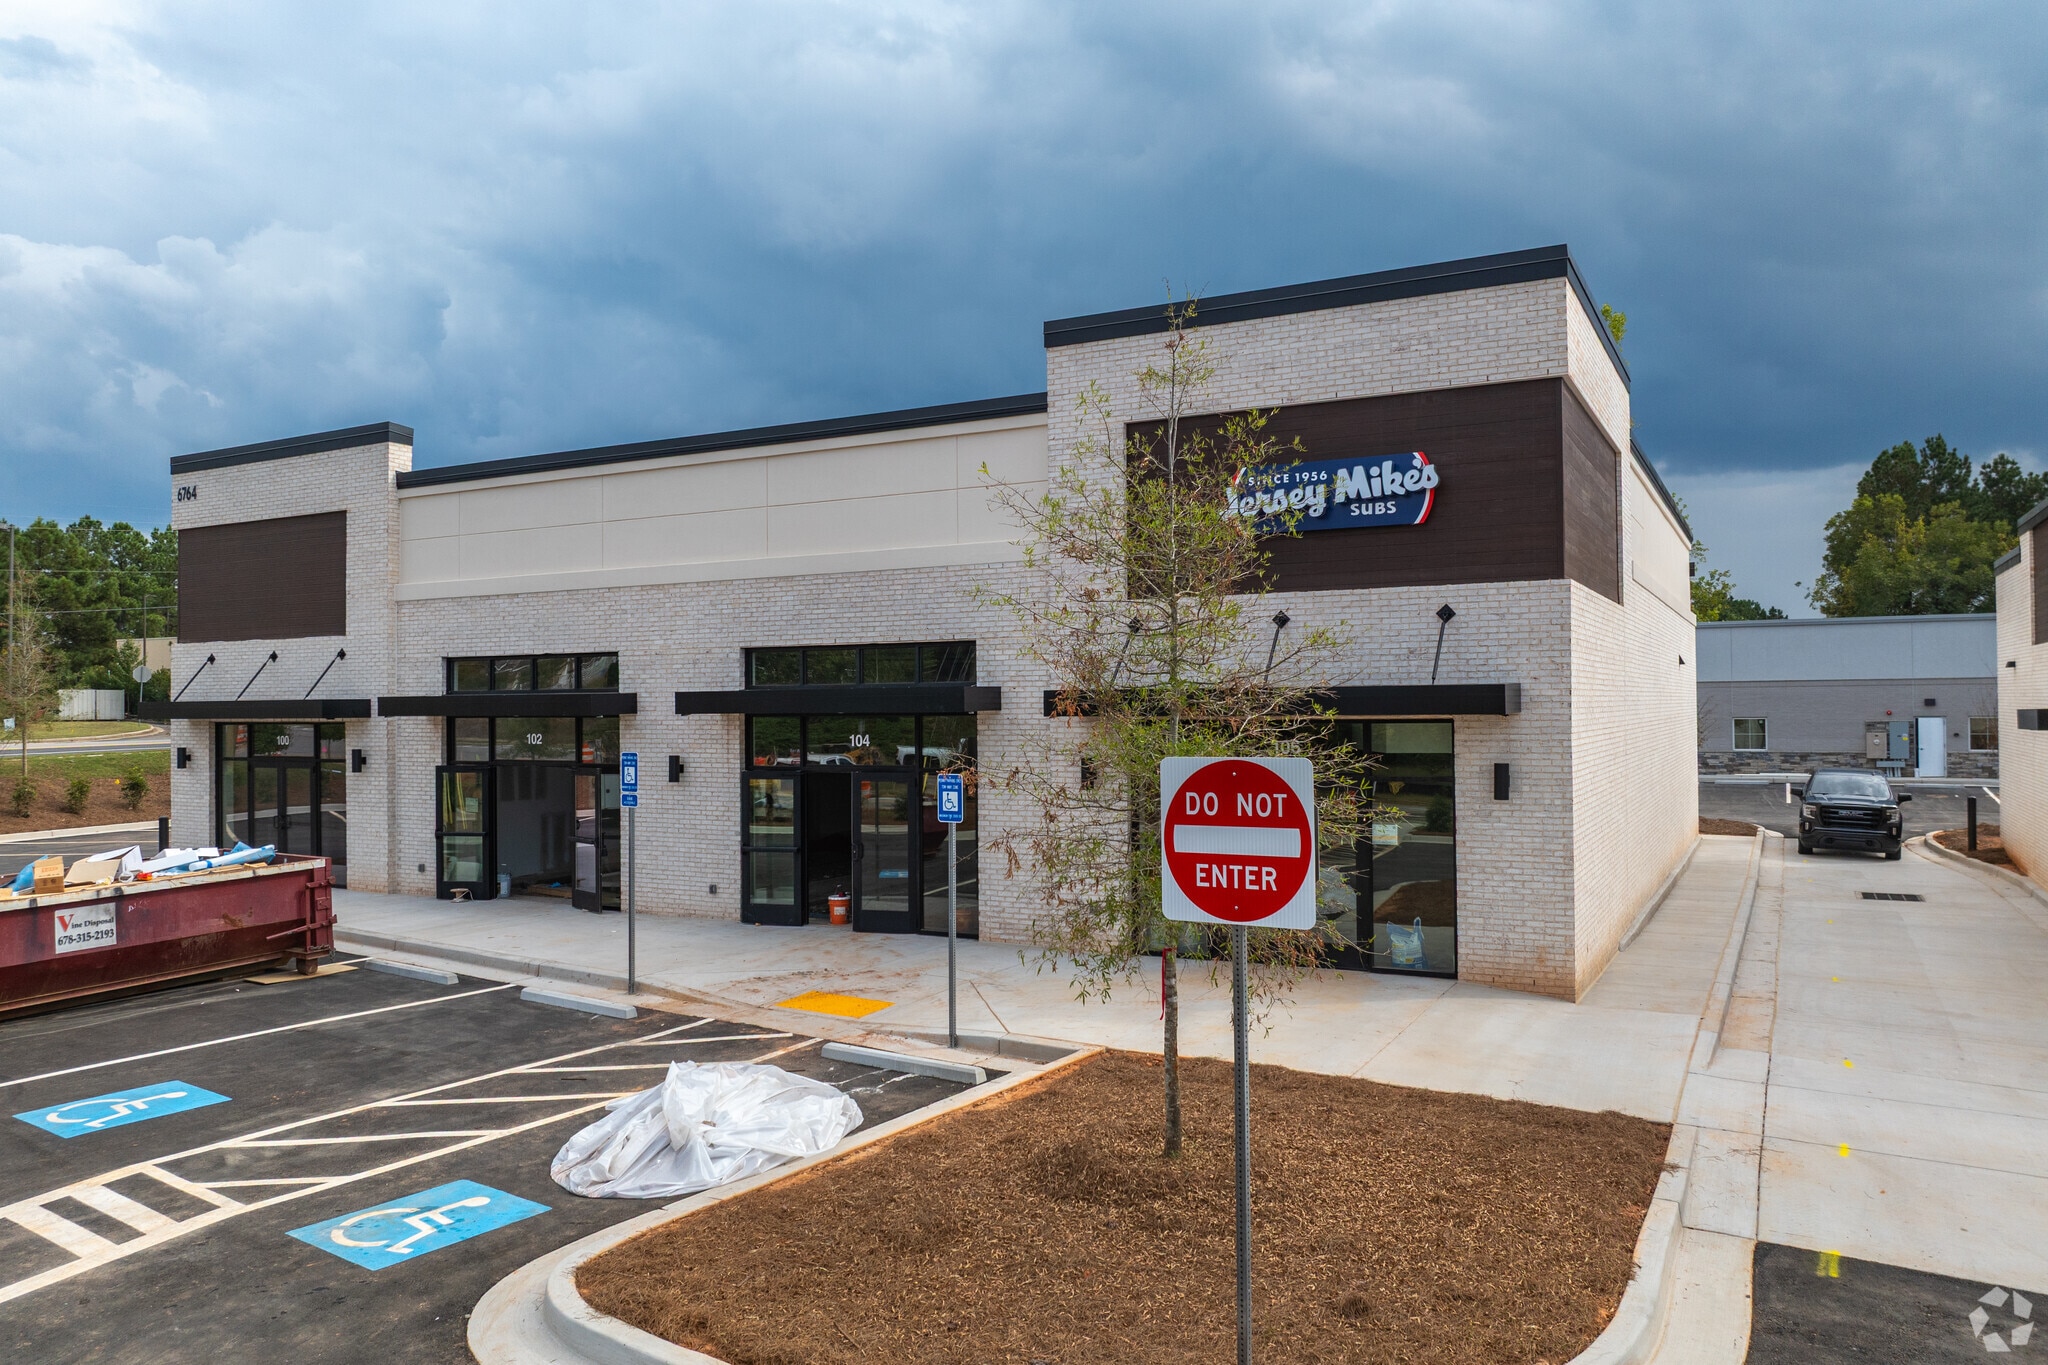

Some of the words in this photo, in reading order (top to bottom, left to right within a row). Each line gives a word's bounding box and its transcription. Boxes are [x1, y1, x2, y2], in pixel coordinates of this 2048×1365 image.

[1295, 471, 1328, 483] 1956
[1334, 458, 1439, 504] Mike's
[177, 485, 197, 501] 6764
[1350, 501, 1397, 516] SUBS
[276, 735, 290, 746] 100
[526, 733, 543, 745] 102
[849, 734, 870, 747] 104
[1185, 791, 1219, 816] DO
[1237, 793, 1288, 818] NOT
[1196, 863, 1277, 891] ENTER
[56, 914, 83, 933] Vine
[84, 917, 115, 928] Disposal
[57, 928, 115, 946] 678-315-2193
